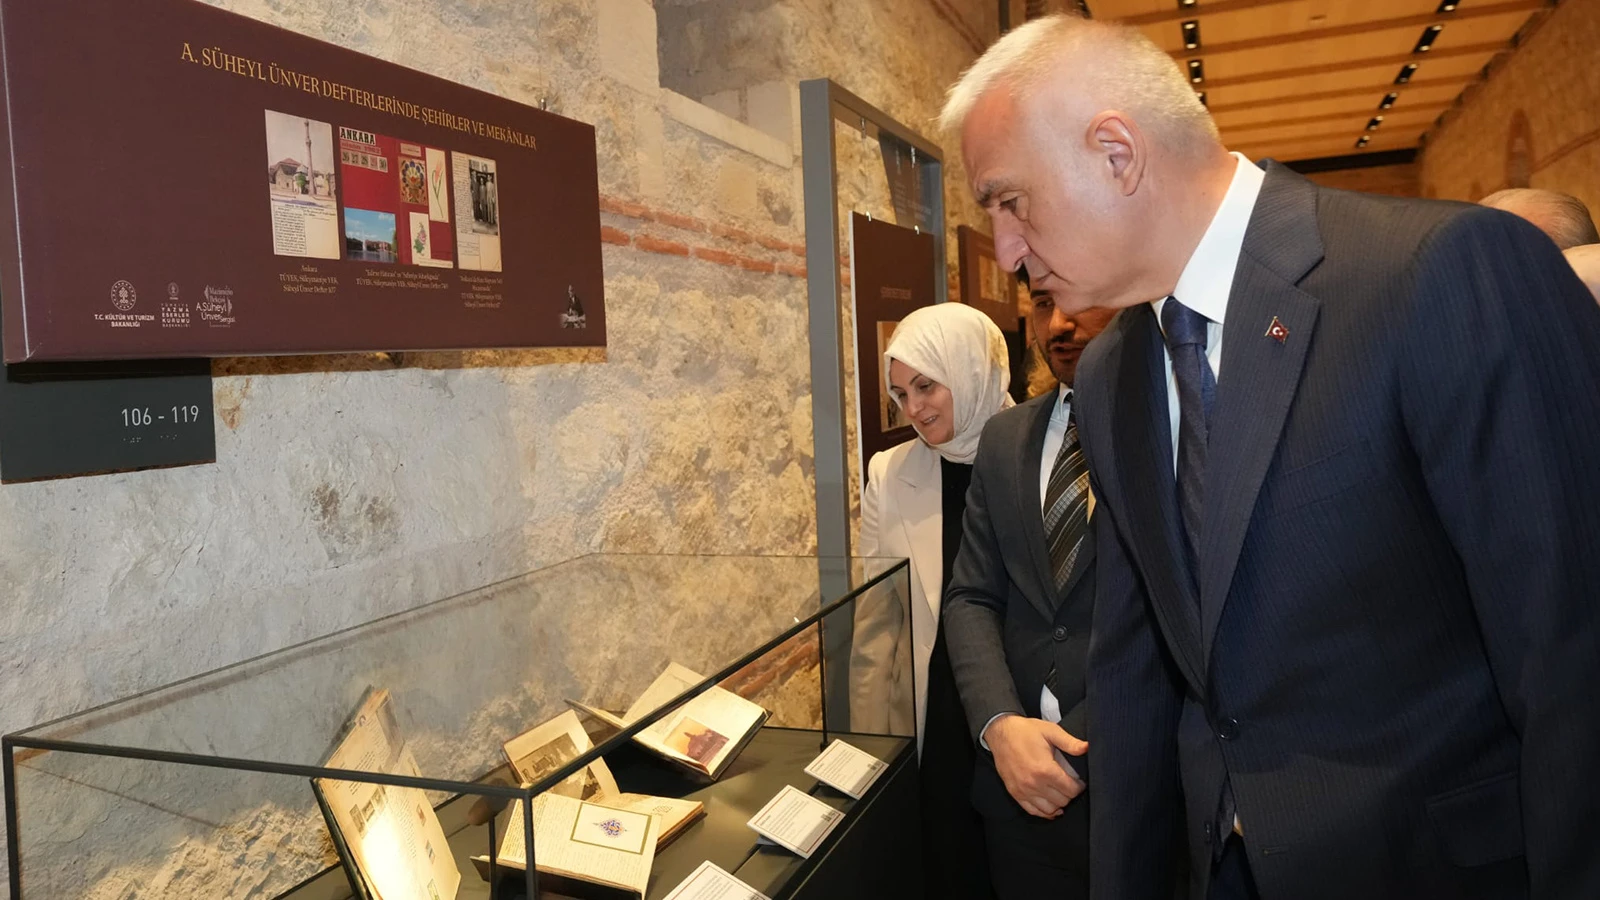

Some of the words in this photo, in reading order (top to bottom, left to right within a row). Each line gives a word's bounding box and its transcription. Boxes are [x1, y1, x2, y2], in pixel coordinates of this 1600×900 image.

[181, 42, 199, 64] A.
[202, 46, 266, 81] SÜHEYL
[268, 62, 321, 97] ÜNVER
[322, 80, 420, 120] DEFTERLERİNDE
[421, 107, 471, 136] ŞEHİRLER
[471, 120, 485, 136] VE
[486, 125, 537, 150] MEKÂNLAR
[340, 127, 375, 145] ANKARA
[104, 312, 126, 321] KÜLTÜR
[121, 407, 152, 427] 106
[171, 405, 199, 423] 119
